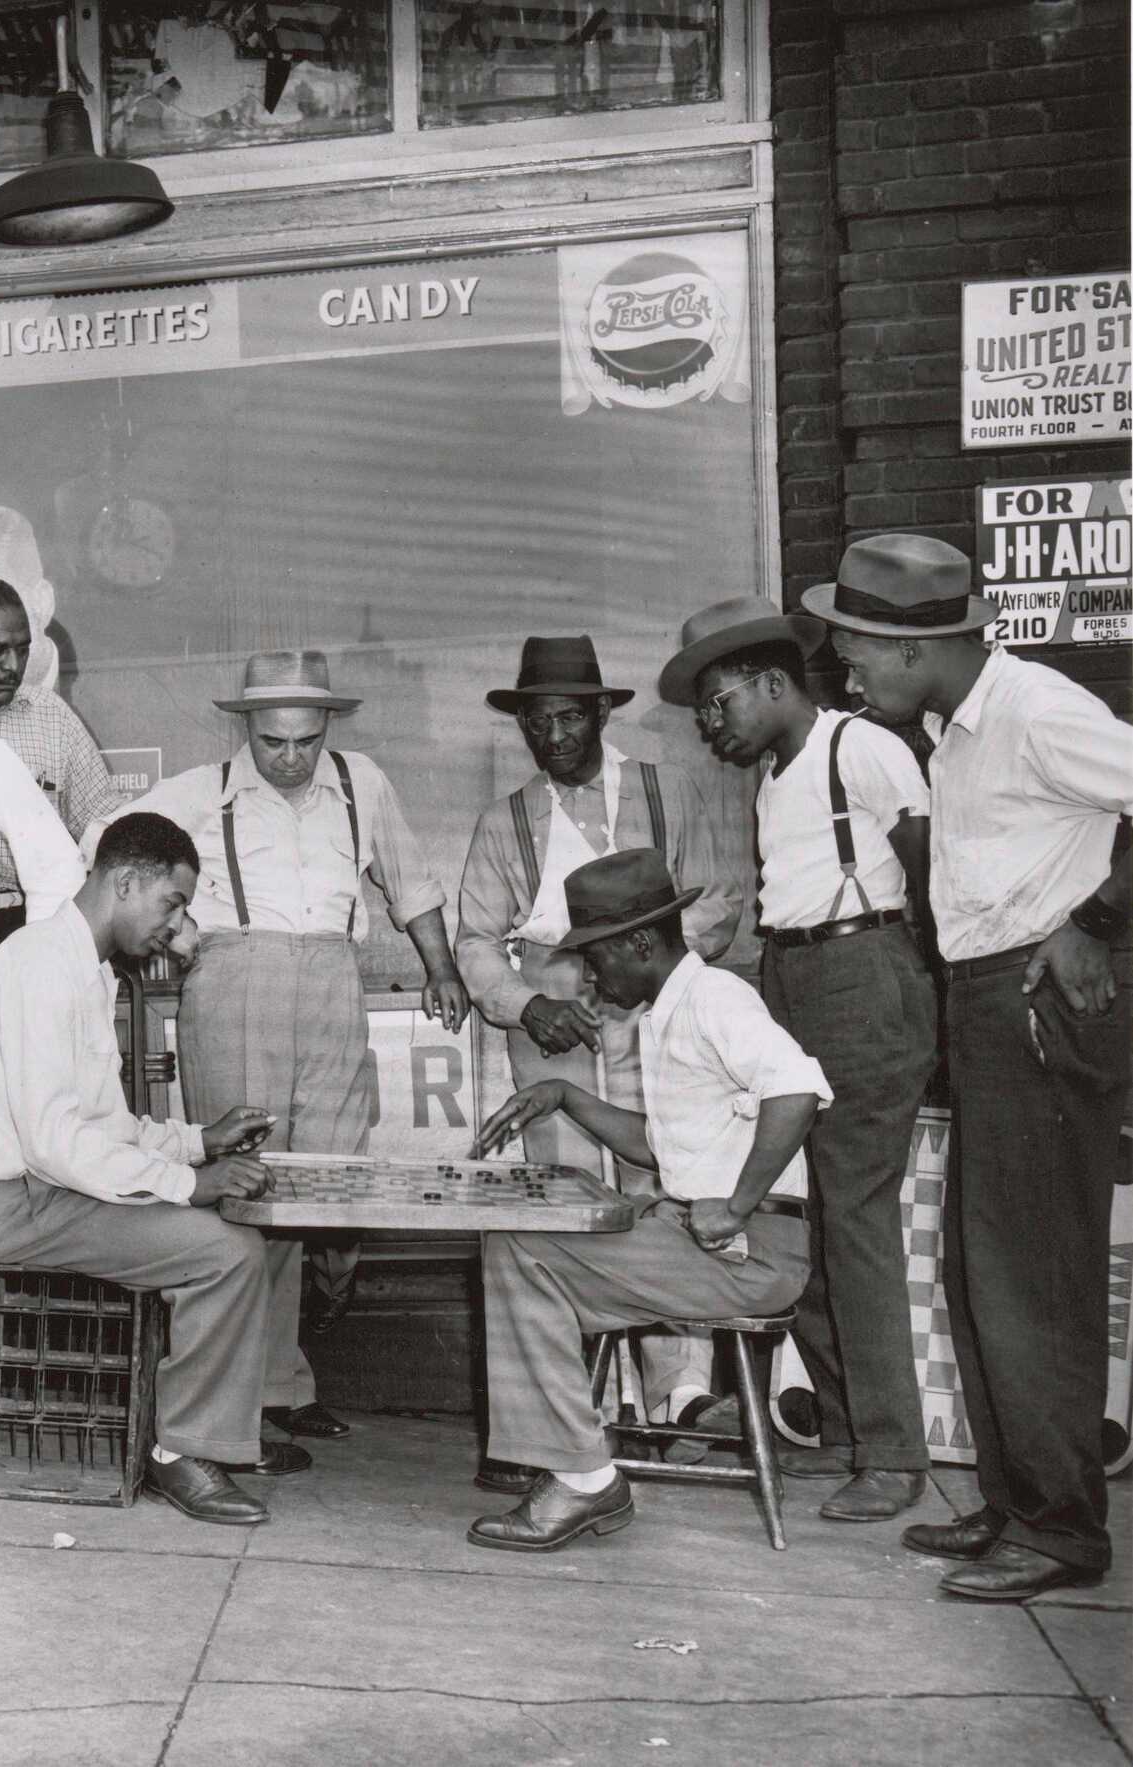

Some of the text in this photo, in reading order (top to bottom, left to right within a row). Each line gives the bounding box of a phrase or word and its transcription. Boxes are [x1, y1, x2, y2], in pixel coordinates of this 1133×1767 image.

[319, 276, 480, 328] CANDY
[1009, 283, 1076, 315] FOR
[977, 322, 1086, 373] UNITED
[971, 396, 1034, 421] UNION
[1041, 391, 1106, 416] TRUST
[971, 424, 1024, 440] FOURTH
[1030, 421, 1076, 436] FLOOR
[996, 487, 1074, 518] FOR
[995, 617, 1047, 640] 2110
[1084, 618, 1128, 630] FORBES
